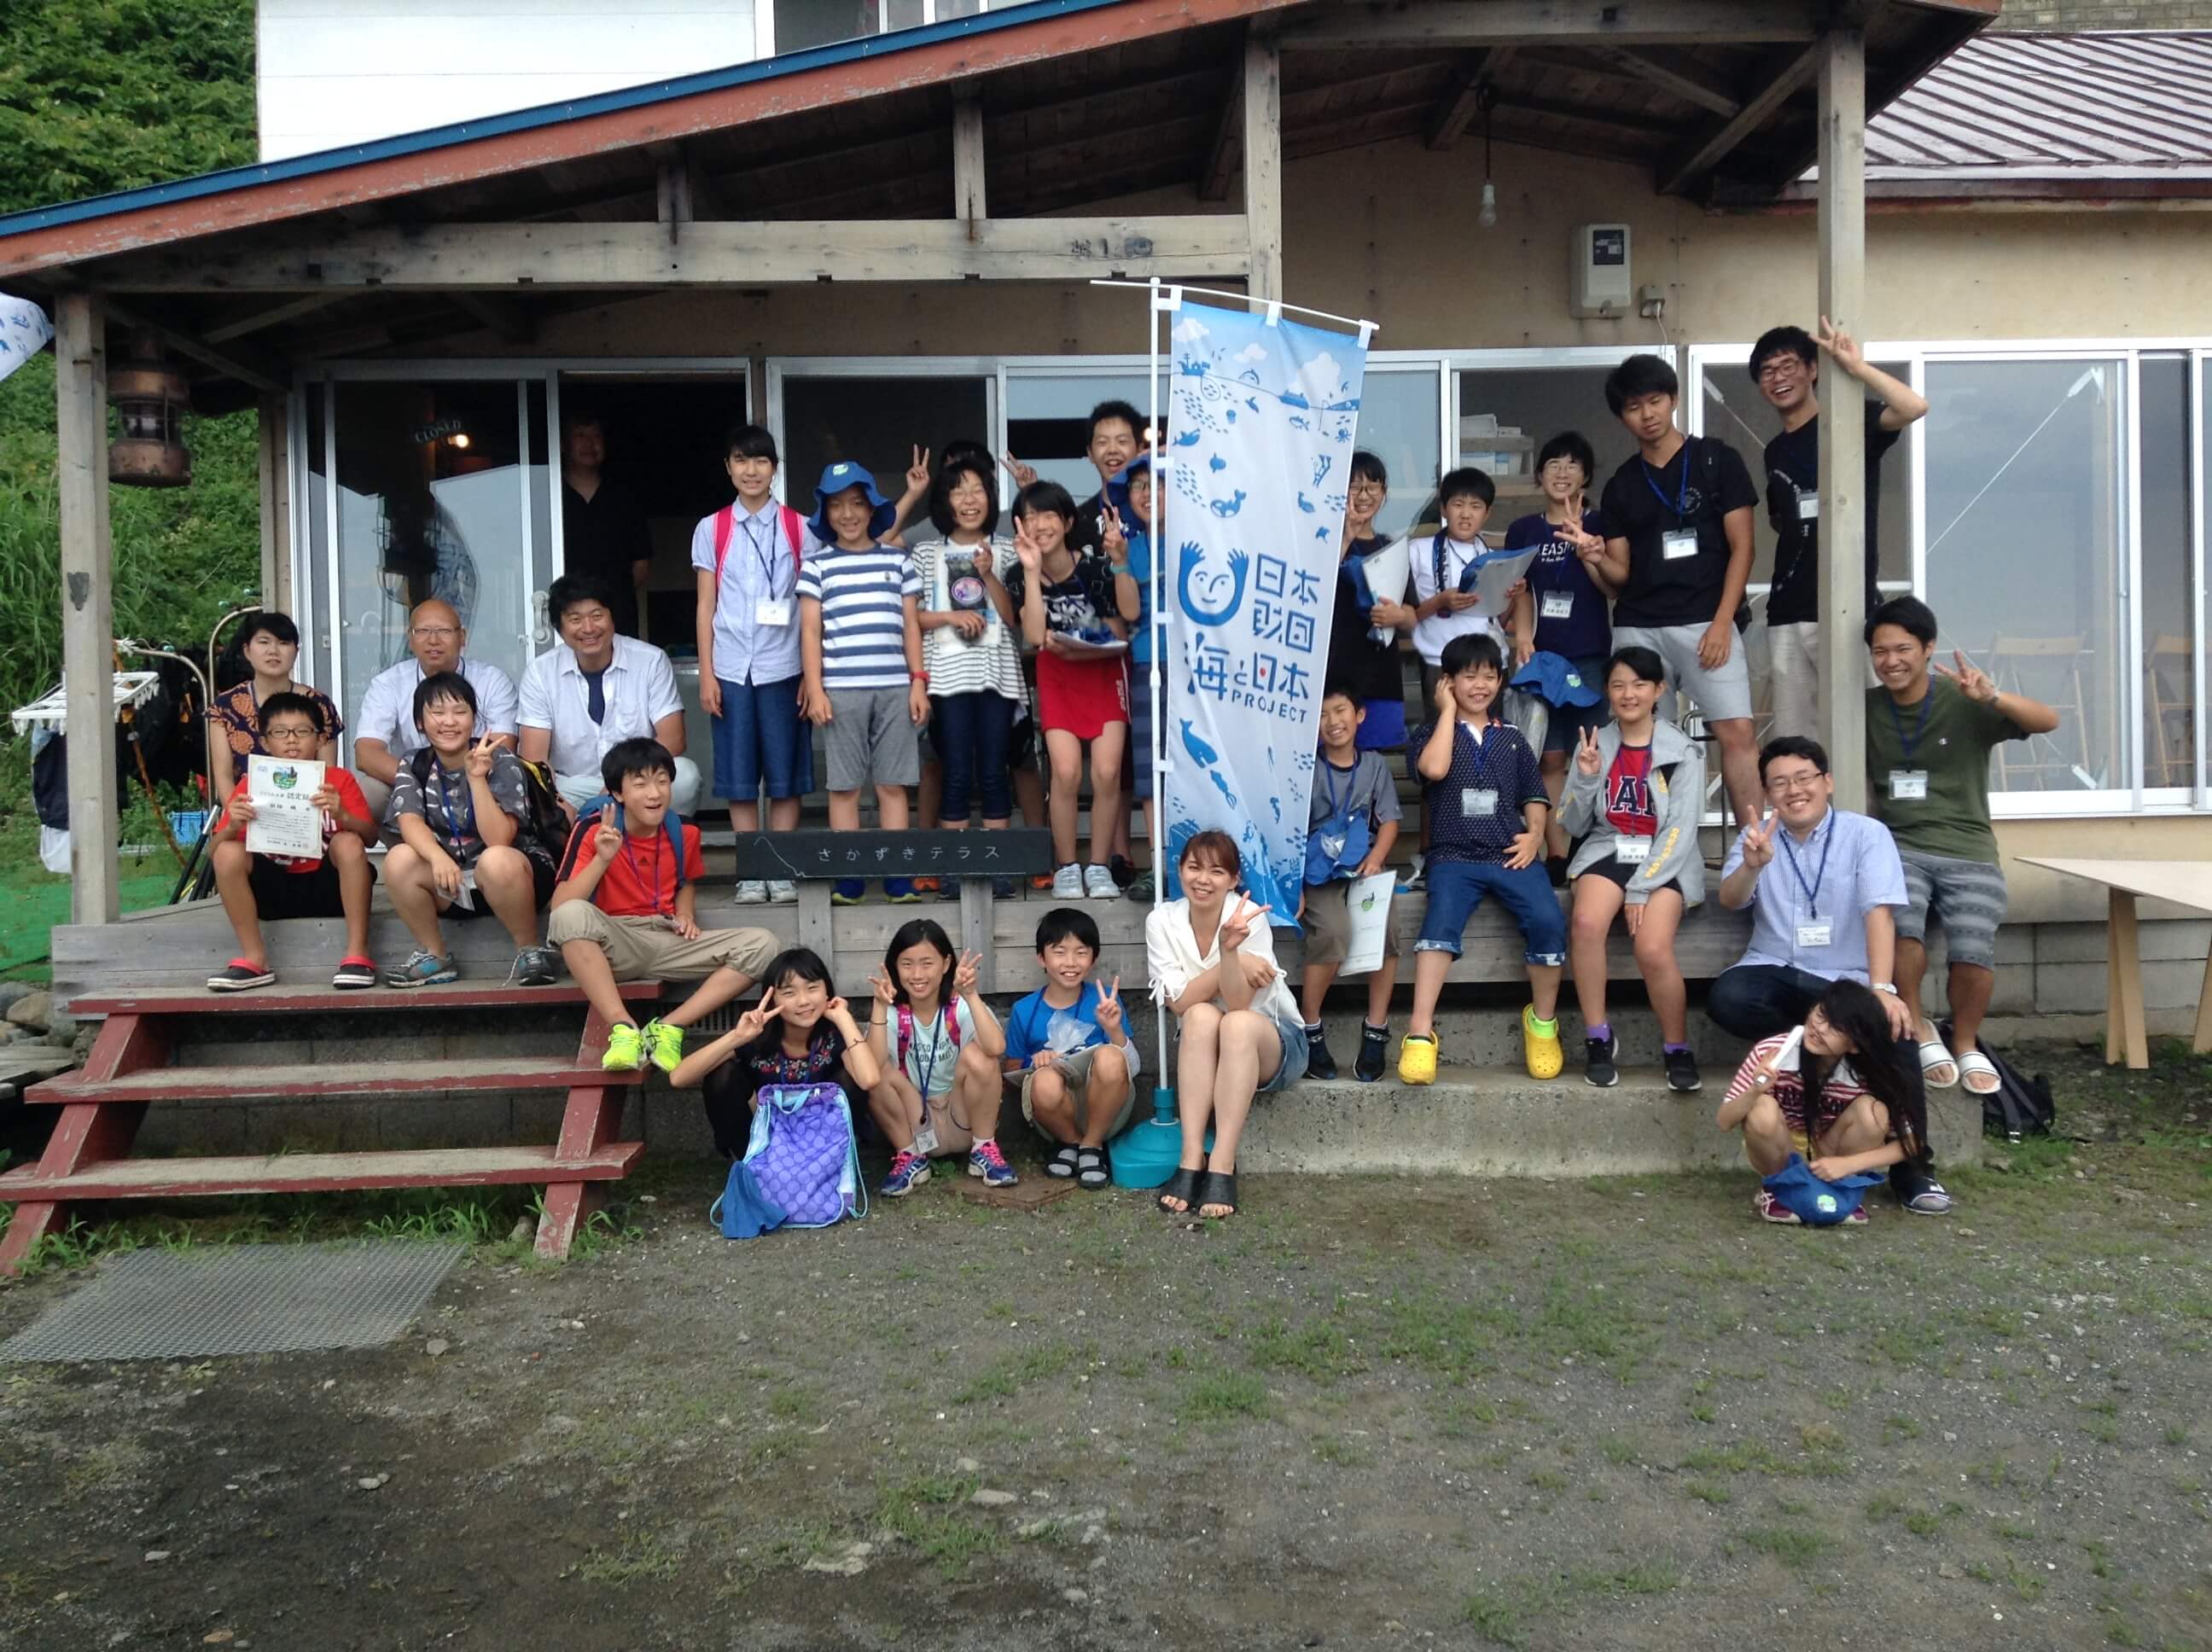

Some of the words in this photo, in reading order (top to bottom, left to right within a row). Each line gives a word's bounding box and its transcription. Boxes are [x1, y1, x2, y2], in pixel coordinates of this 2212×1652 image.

[1256, 553, 1321, 606] 日本
[1184, 631, 1311, 702] 海と日本
[1231, 689, 1308, 724] PROJECT
[818, 846, 1000, 862] さかずきテラス
